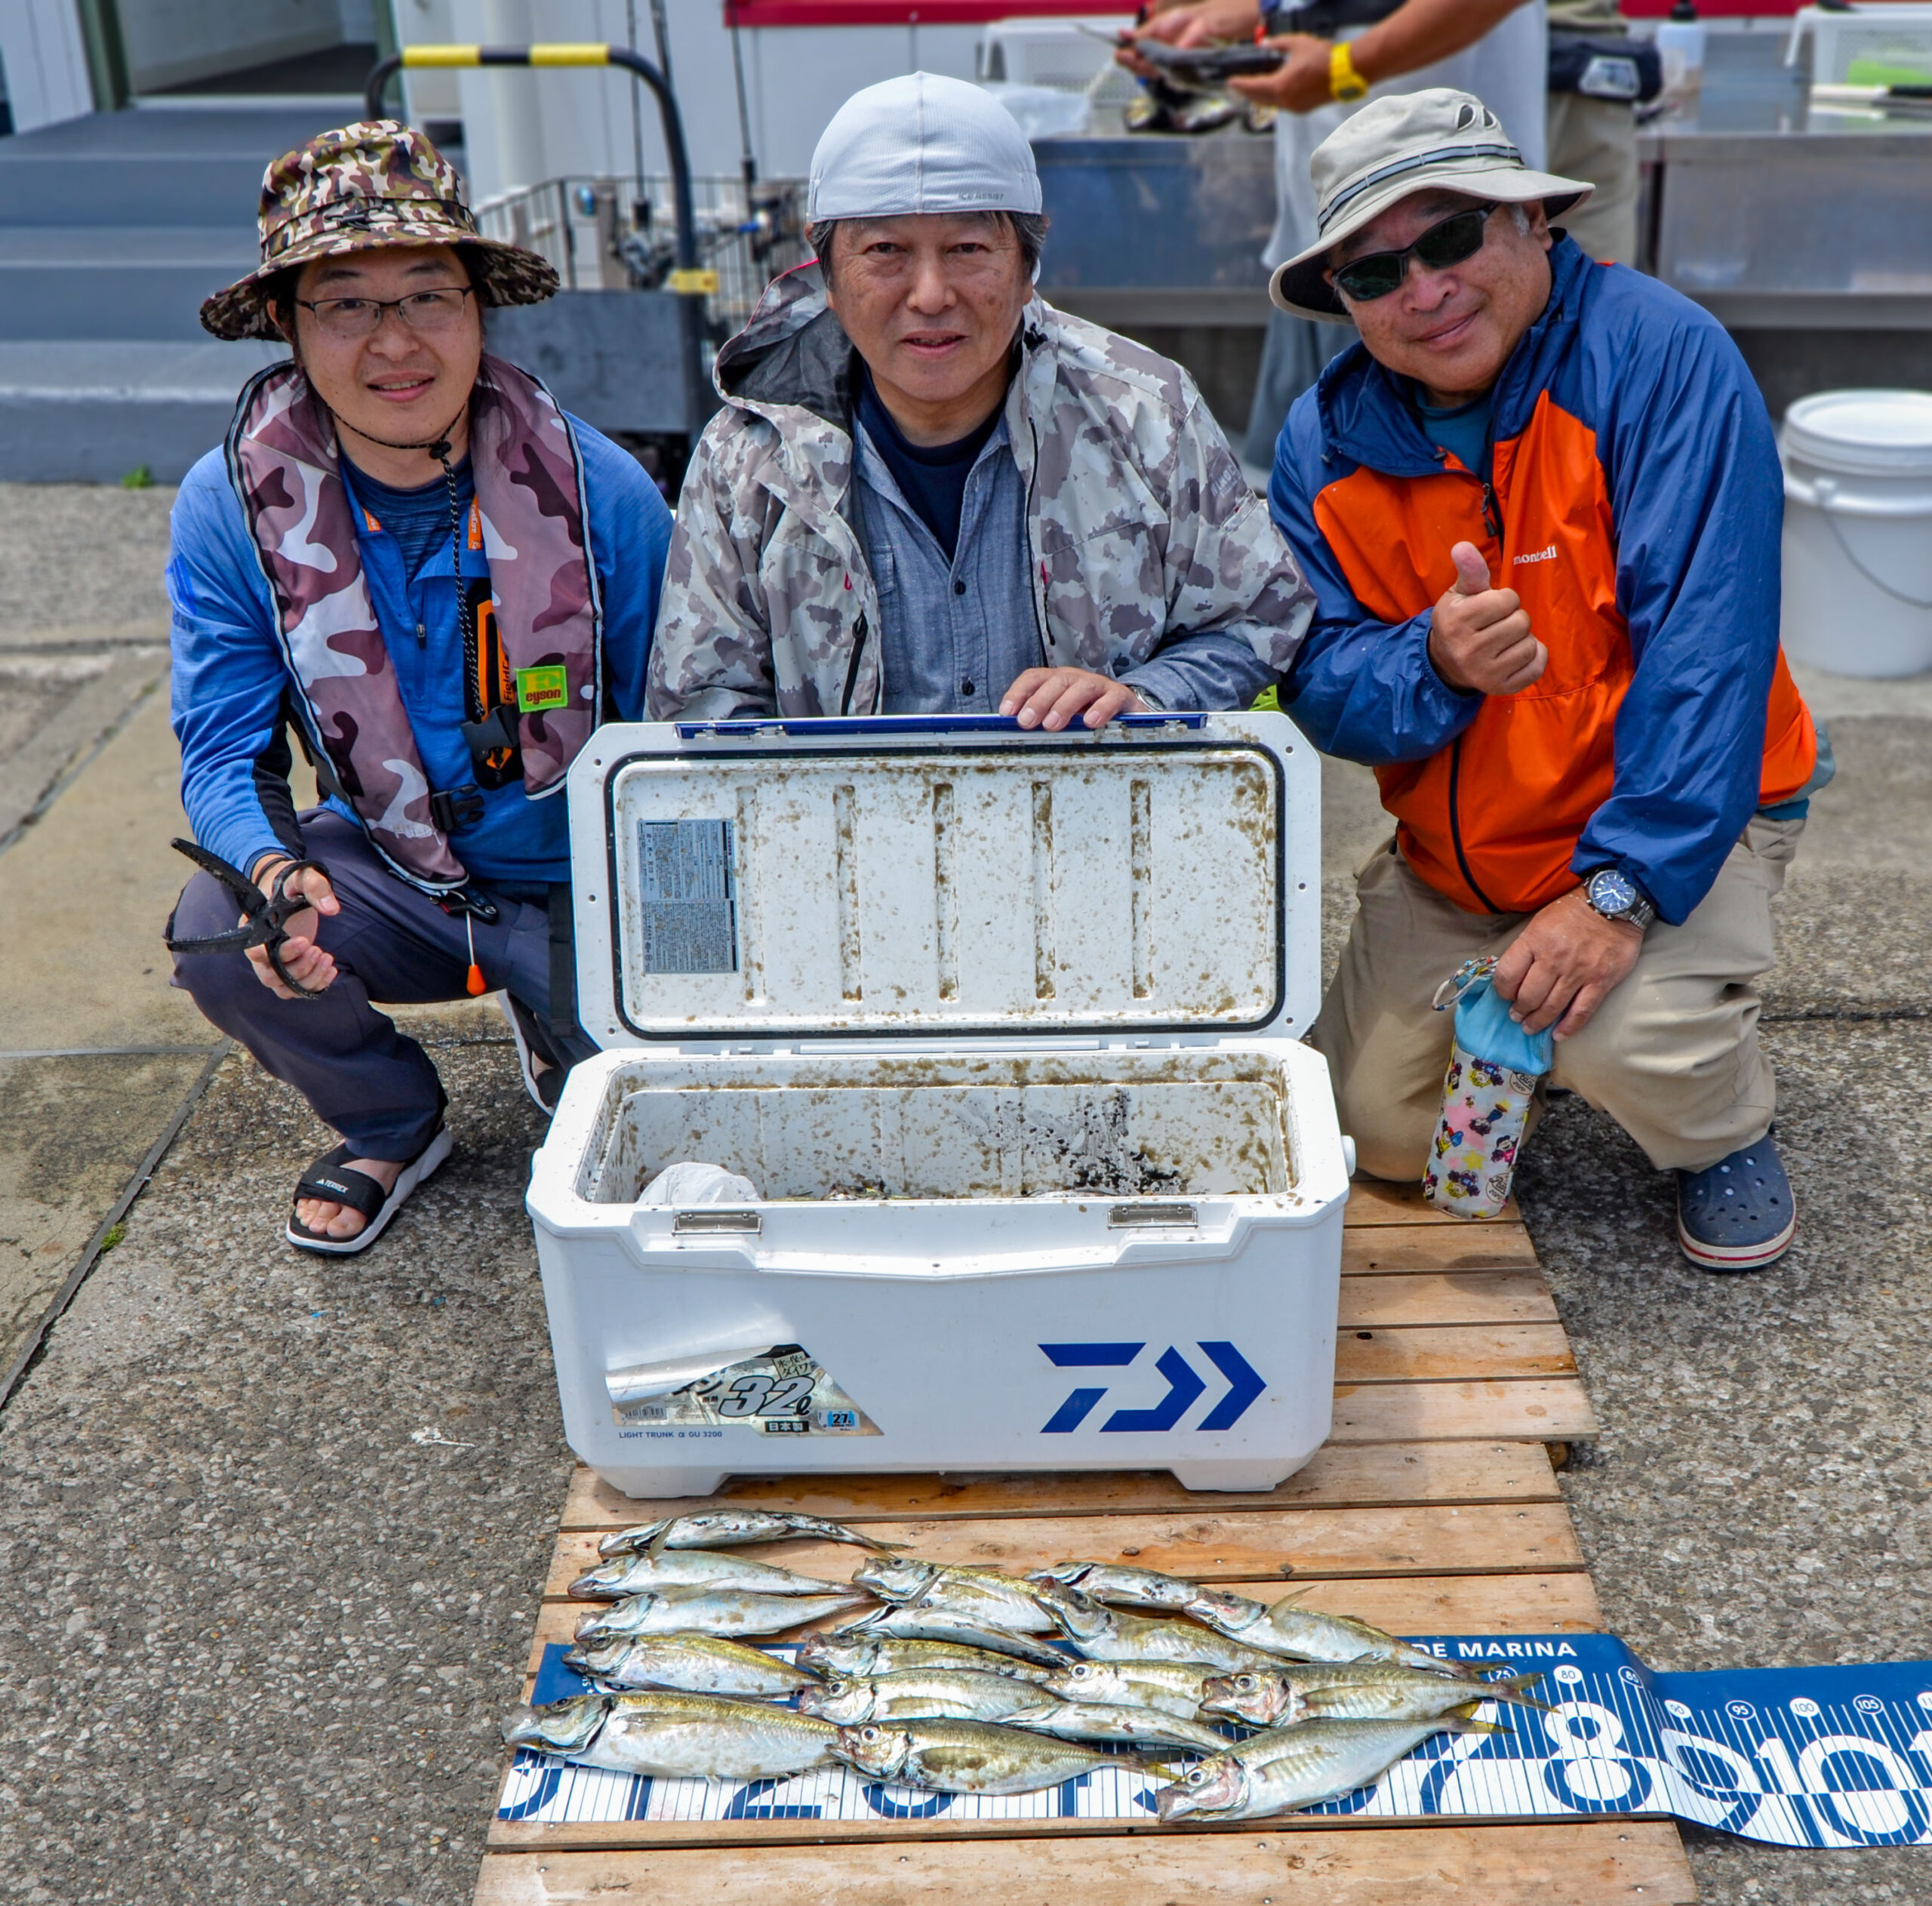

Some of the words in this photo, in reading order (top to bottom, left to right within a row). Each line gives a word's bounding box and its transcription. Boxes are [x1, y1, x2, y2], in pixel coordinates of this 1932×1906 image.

[525, 688, 561, 704] eyson
[770, 1422, 804, 1431] 日本製
[1458, 1643, 1577, 1657] MARINA
[1561, 1670, 1576, 1679] 80
[1625, 1670, 1638, 1683] 85
[1732, 1704, 1749, 1715] 95
[1794, 1702, 1814, 1713] 100
[1857, 1699, 1878, 1710] 105
[1544, 1701, 1653, 1813] 8
[1661, 1728, 1764, 1834] 9
[1754, 1735, 1931, 1847] 10
